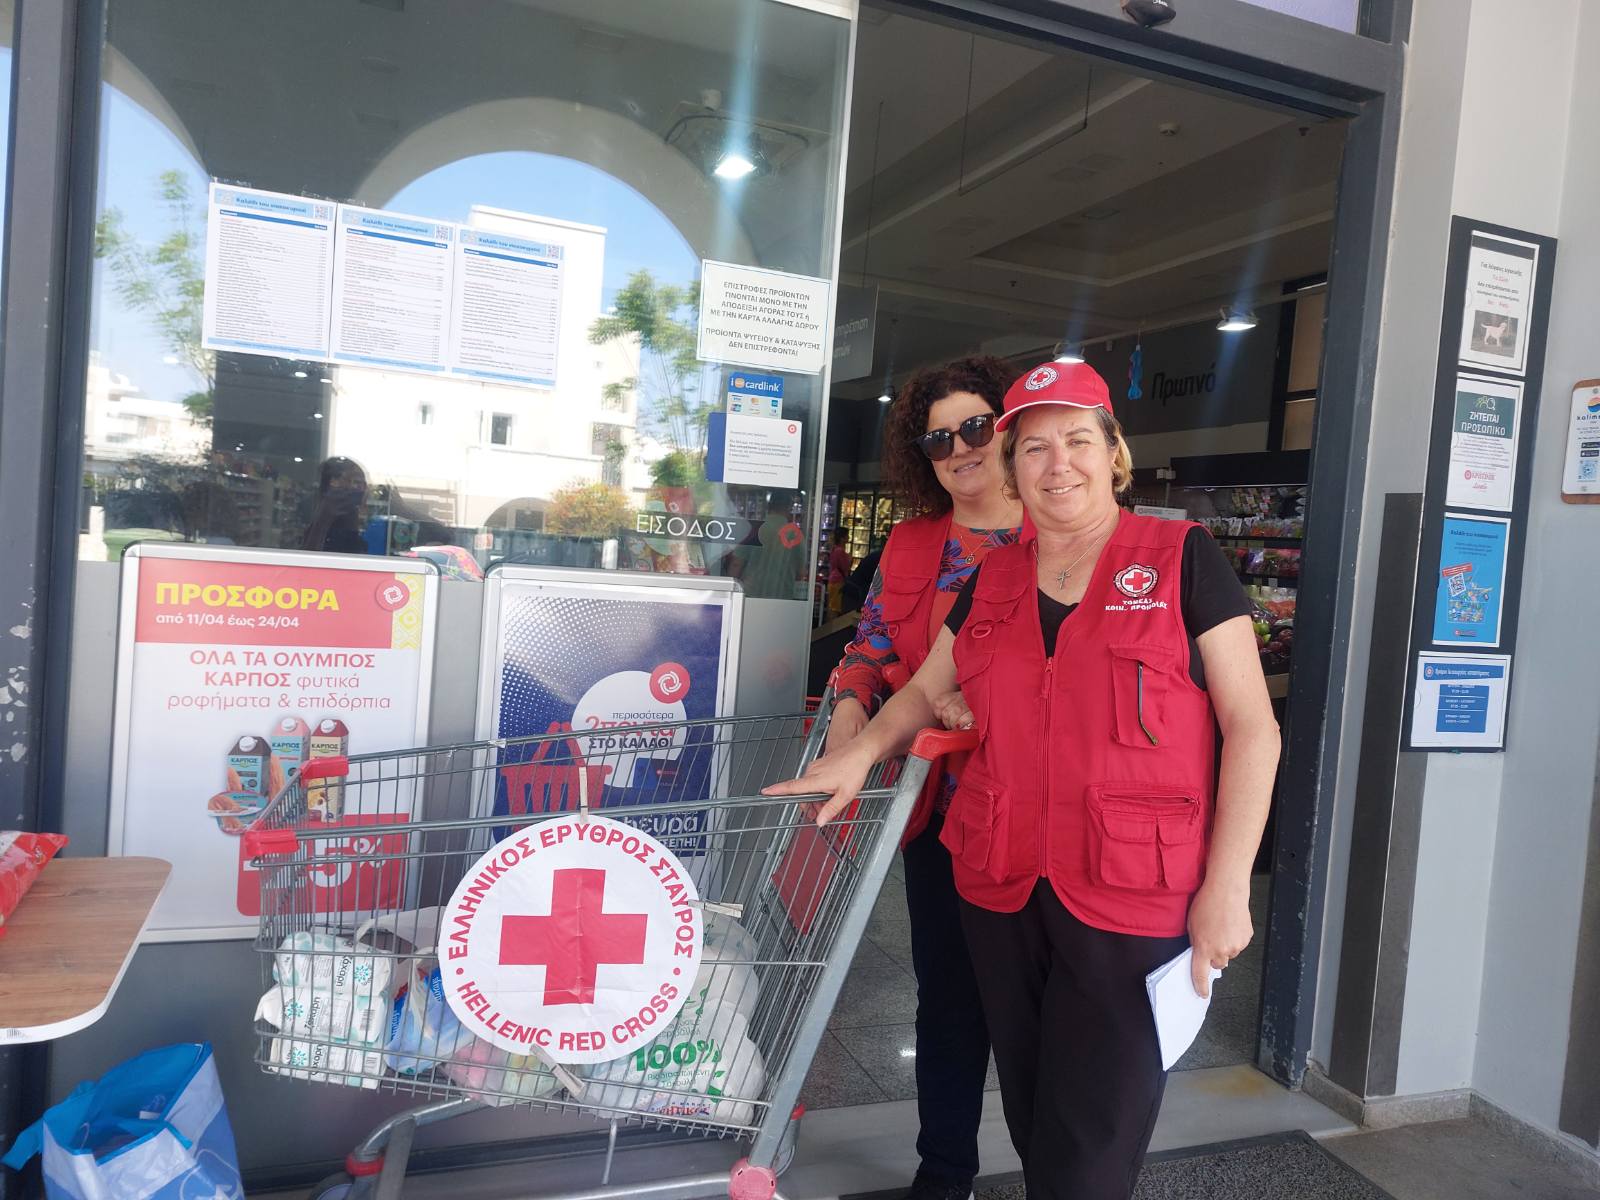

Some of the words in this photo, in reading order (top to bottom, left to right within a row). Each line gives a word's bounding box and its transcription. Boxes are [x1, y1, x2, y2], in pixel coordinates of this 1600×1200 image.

[723, 281, 768, 294] ΕΠΙΣΤΡΟΦΕΣ
[721, 300, 758, 312] ΑΠΟΔΕΙΞΗ
[759, 306, 785, 317] ΑΓΟΡΑΣ
[786, 311, 804, 320] ΤΟΥΣ
[725, 291, 758, 302] ΓΙΝΟΝΤΑΙ
[759, 296, 781, 306] ΜΟΝΟ
[782, 300, 793, 308] ΜΕ
[794, 301, 808, 310] ΤΗΝ
[710, 309, 721, 317] ΜΕ
[722, 311, 737, 319] ΤΗΝ
[738, 313, 761, 323] ΚΑΡΤΑ
[762, 316, 794, 327] ΑΛΛΑΓΗΣ
[795, 321, 819, 331] ΔΩΡΟΥ
[728, 340, 743, 349] ΔΕΝ
[743, 332, 773, 343] ΨΥΓΕΙΟΥ
[781, 338, 821, 350] ΚΑΤΑΨΥΞΗΣ
[745, 381, 780, 392] cardlink
[1151, 362, 1217, 406] Πρωινό
[1469, 411, 1500, 424] ΖΗΤΕΙΤΑΙ
[1461, 422, 1506, 436] ΠΡΟΣΩΠΙΚΟ
[636, 514, 737, 541] ΕΙΣΟΔΟΣ
[155, 581, 340, 612] ΠΡΟΣΦΟΡΑ
[155, 612, 184, 625] από
[186, 613, 225, 626] 11/04
[227, 613, 255, 628] έως
[257, 615, 300, 629] 24/04
[189, 650, 237, 666] ΟΛΑ
[242, 651, 268, 667] ΤΑ
[273, 652, 376, 668] ΟΛΥΜΠΟΣ
[204, 671, 291, 687] ΚΑΡΠΟΣ
[296, 673, 360, 690] φυτικά
[167, 692, 271, 711] ροφήματα
[278, 694, 291, 708] &
[297, 692, 391, 711] επιδόρπια
[612, 709, 674, 721] περισσότερα
[589, 738, 616, 749] ΣΤΟ
[619, 737, 673, 749] ΚΑΛΑΘΙ
[448, 837, 536, 960] ΕΛΛΗΝΙΚΟΣ
[539, 823, 656, 864] ΕΡΥΘΡΟΣ
[649, 857, 695, 959] ΣΤΑΥΡΟΣ
[456, 981, 552, 1047] HELLENIC
[559, 1031, 606, 1051] RED
[611, 982, 679, 1044] CROSS
[631, 1038, 723, 1072] 100%
